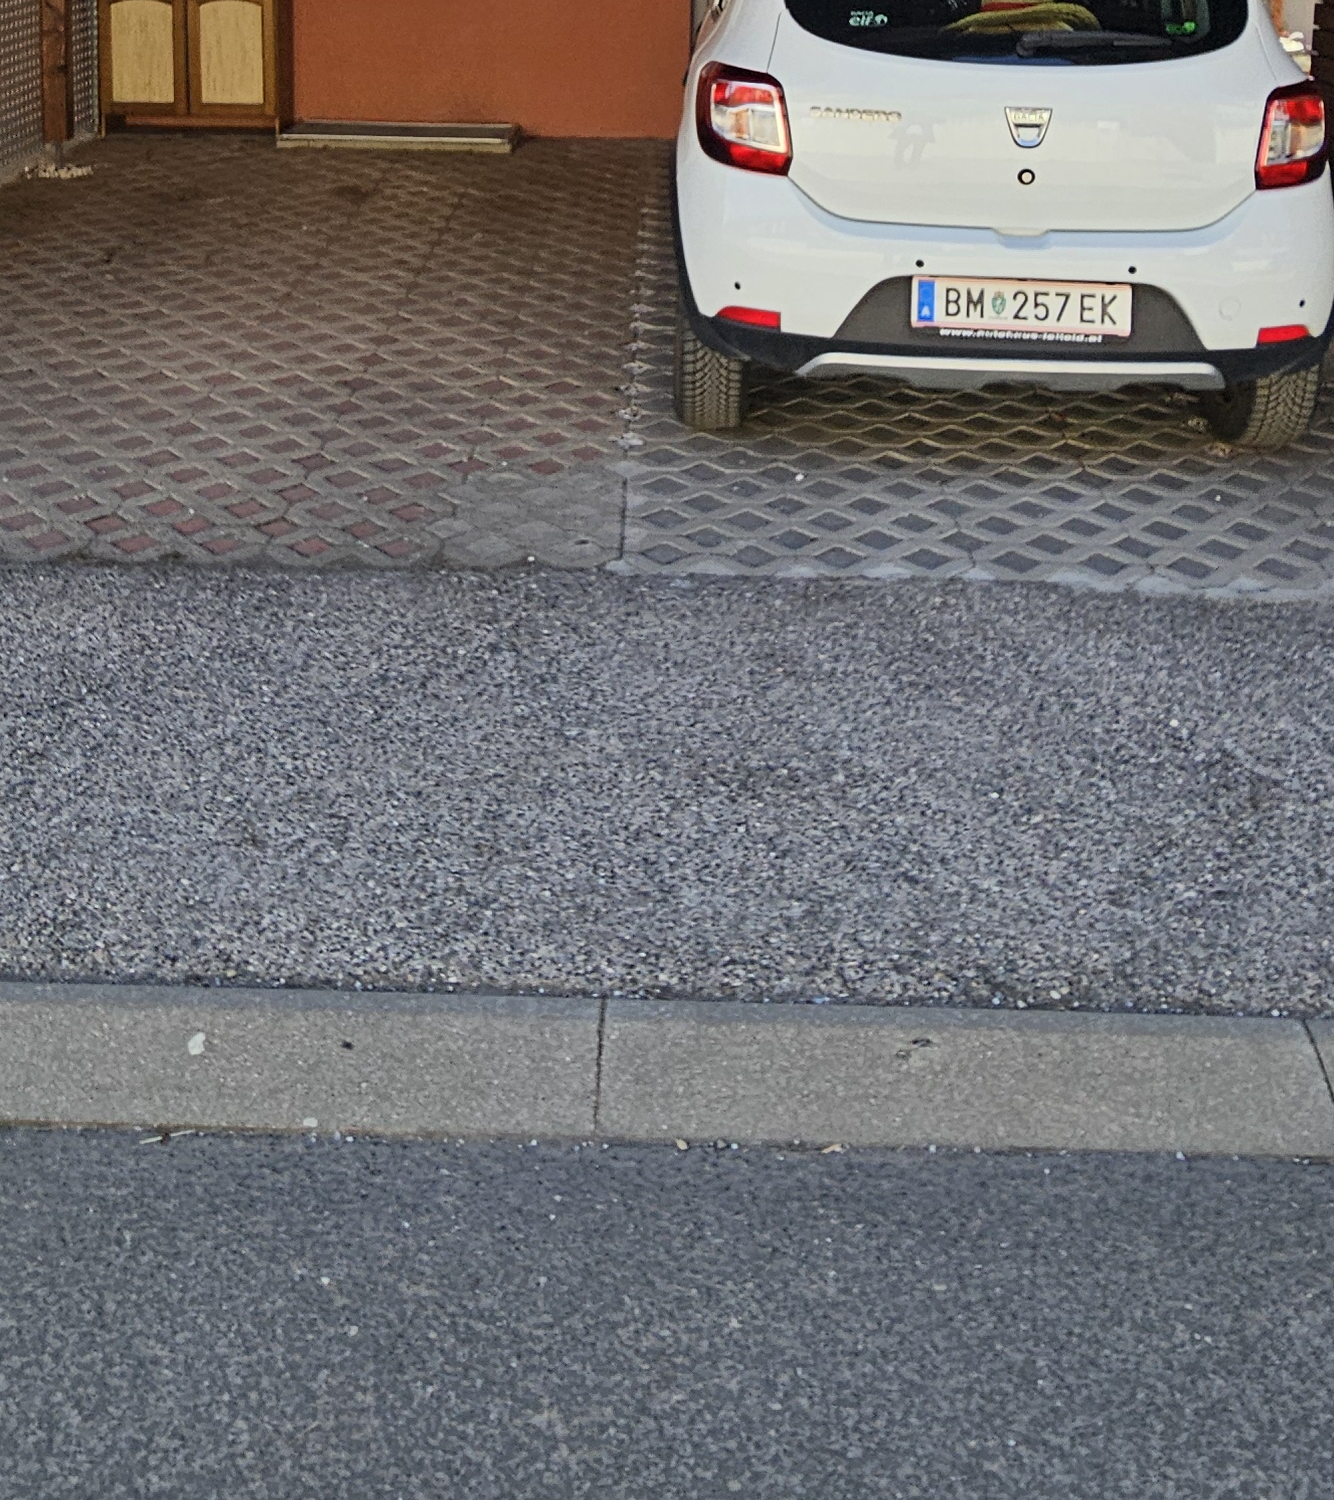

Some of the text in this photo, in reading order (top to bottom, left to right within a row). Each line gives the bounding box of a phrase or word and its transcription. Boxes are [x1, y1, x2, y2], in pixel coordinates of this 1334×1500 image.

[921, 287, 1117, 325] A BM 257 EK
